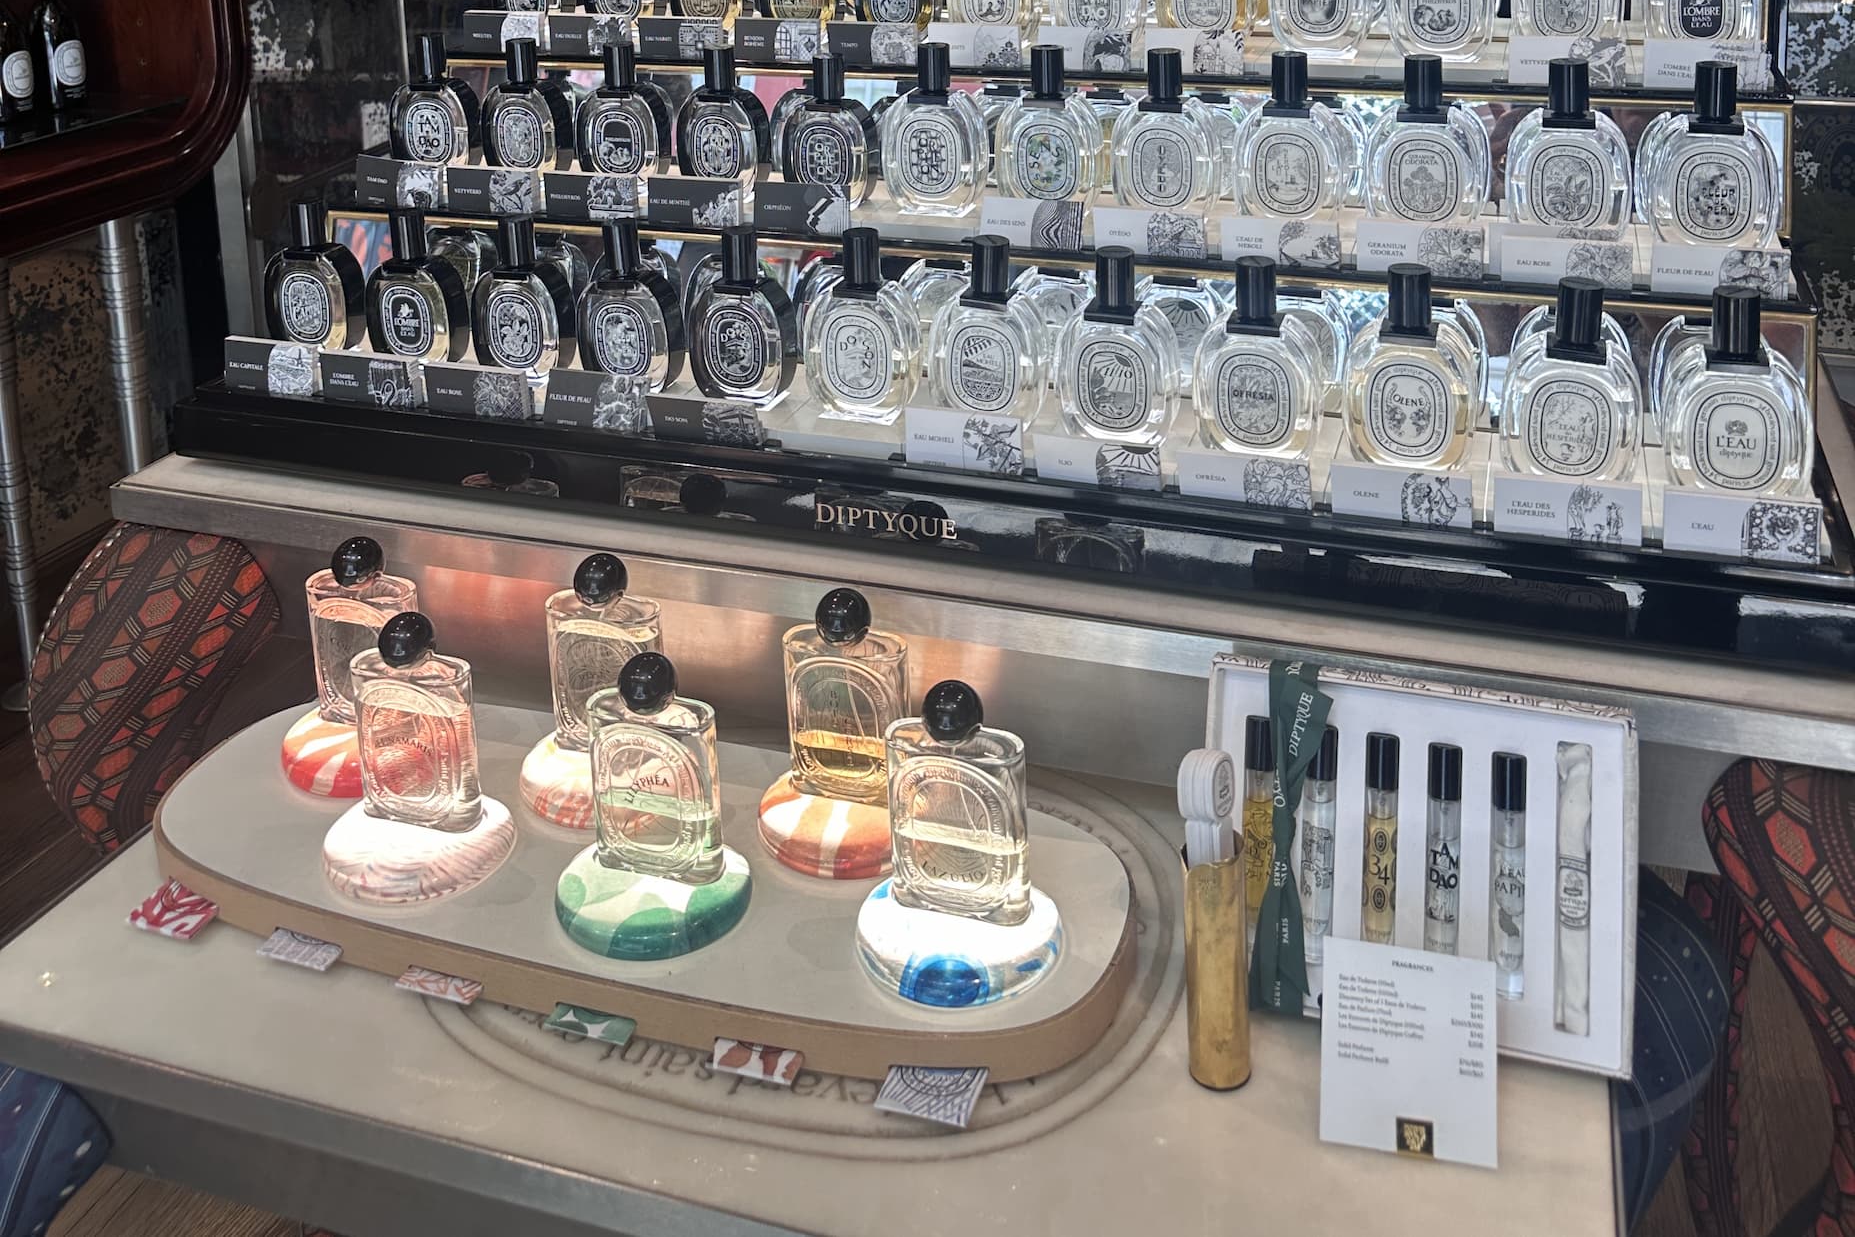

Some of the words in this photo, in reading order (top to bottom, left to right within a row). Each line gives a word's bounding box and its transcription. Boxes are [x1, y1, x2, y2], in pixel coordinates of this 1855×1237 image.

[1081, 6, 1108, 17] DAO
[1683, 6, 1721, 17] L'OMBRE
[1367, 241, 1407, 250] GERANIUM
[1370, 249, 1405, 258] ODORATA
[1657, 267, 1681, 275] FLEUR
[1682, 268, 1694, 276] DE
[1695, 269, 1714, 277] PEAU
[549, 393, 568, 402] FLEUR
[569, 394, 576, 403] DE
[914, 433, 928, 442] EAU
[1716, 434, 1757, 450] L'EAU
[1535, 502, 1551, 510] DES
[816, 502, 958, 541] DIPTYQUE
[1288, 691, 1315, 757] DIPTYQUE
[1430, 842, 1459, 870] TAM
[1369, 854, 1390, 886] 34
[1429, 868, 1458, 890] DAO
[1281, 917, 1289, 944] PARIS
